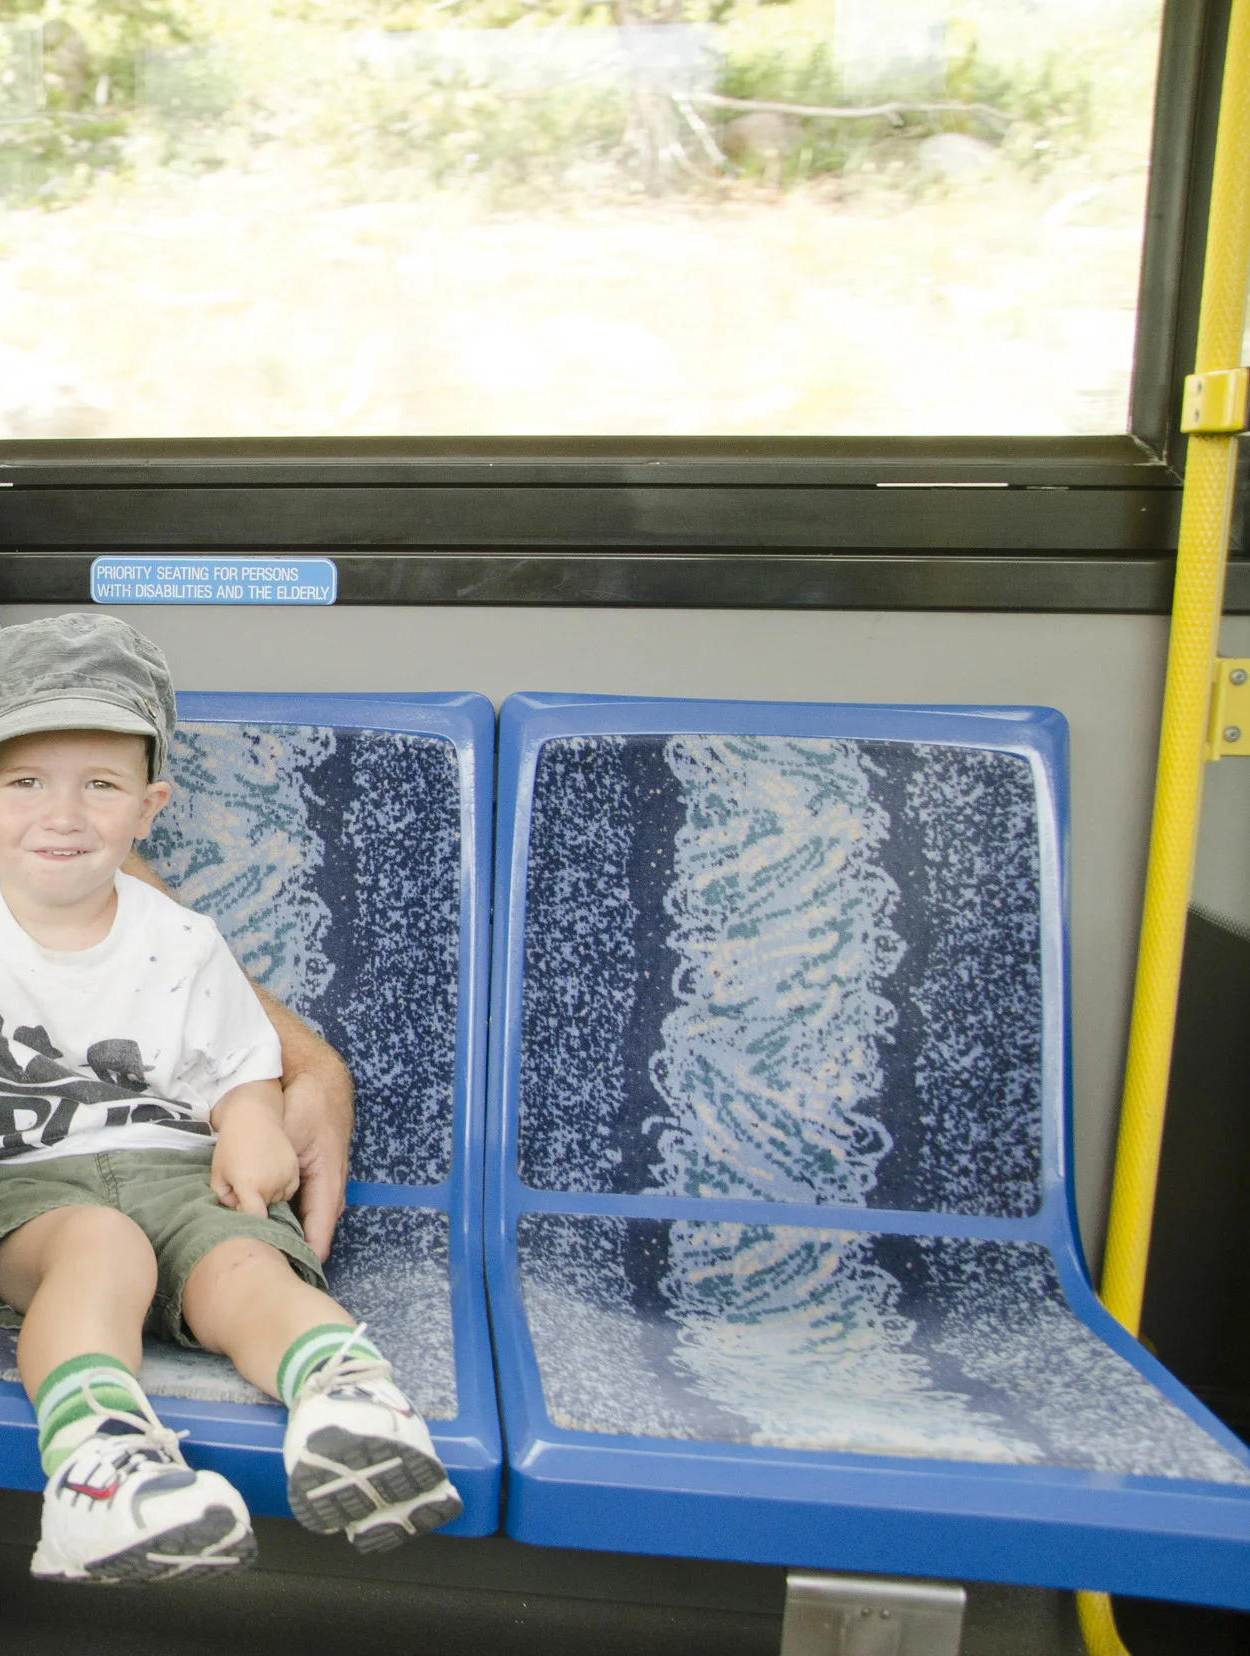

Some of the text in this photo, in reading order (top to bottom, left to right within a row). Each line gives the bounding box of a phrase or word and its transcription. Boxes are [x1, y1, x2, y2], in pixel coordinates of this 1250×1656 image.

[97, 566, 299, 582] PRIORITY SEATING FOR PERSONS
[97, 584, 330, 600] WITH DISABILITIES AND THE ELDERLY
